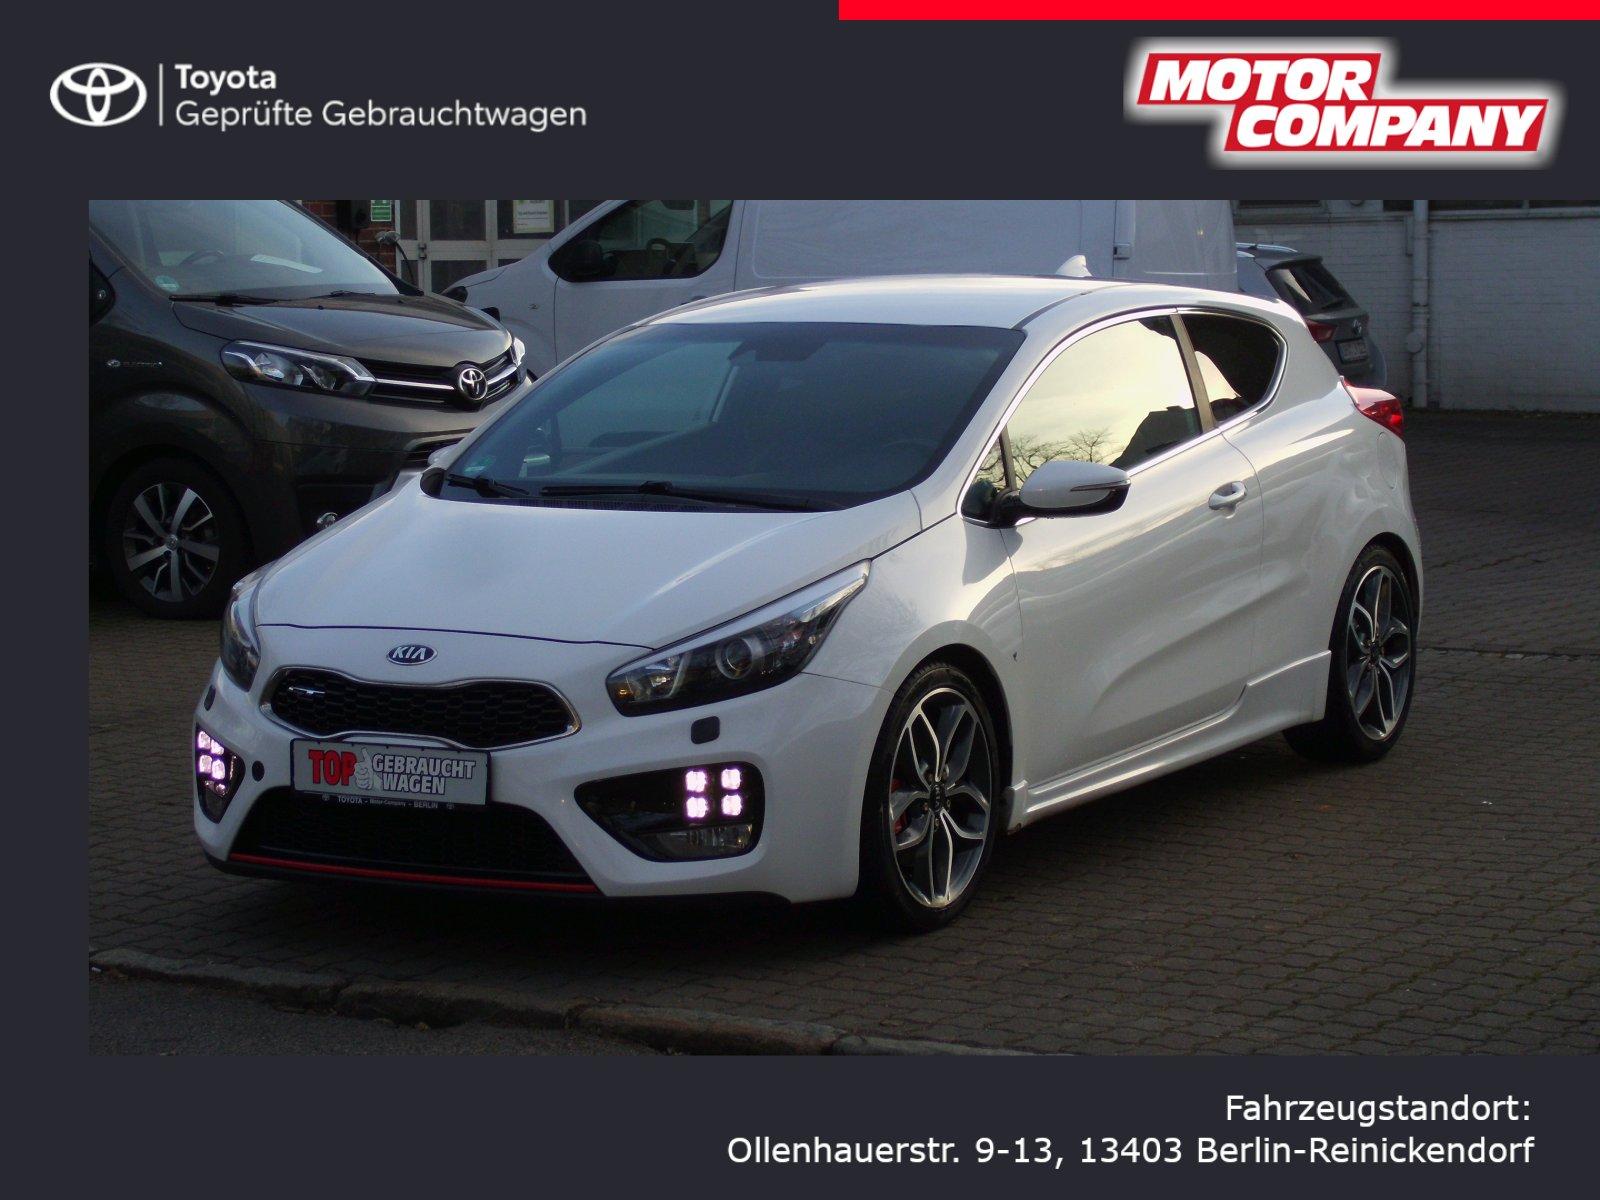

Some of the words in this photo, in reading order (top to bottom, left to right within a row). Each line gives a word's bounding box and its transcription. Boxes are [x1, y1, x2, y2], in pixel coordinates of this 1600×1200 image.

[392, 646, 426, 660] KIA
[308, 749, 358, 786] TOP
[372, 753, 476, 780] GEBRAUCHT
[382, 773, 447, 795] WAGEN
[338, 795, 363, 804] TOYOTA
[413, 801, 438, 809] BERLIN
